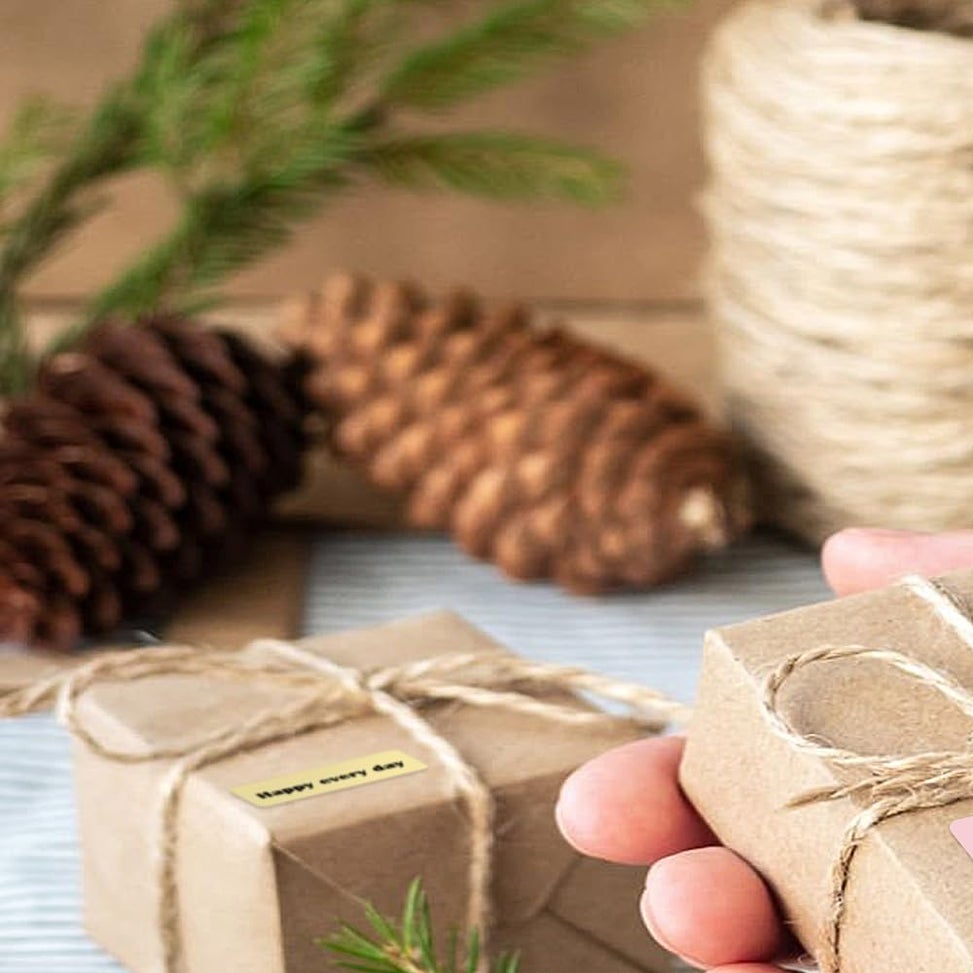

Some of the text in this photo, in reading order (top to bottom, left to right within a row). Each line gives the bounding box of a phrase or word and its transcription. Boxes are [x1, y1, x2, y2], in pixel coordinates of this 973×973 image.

[256, 760, 404, 799] Happy every day
